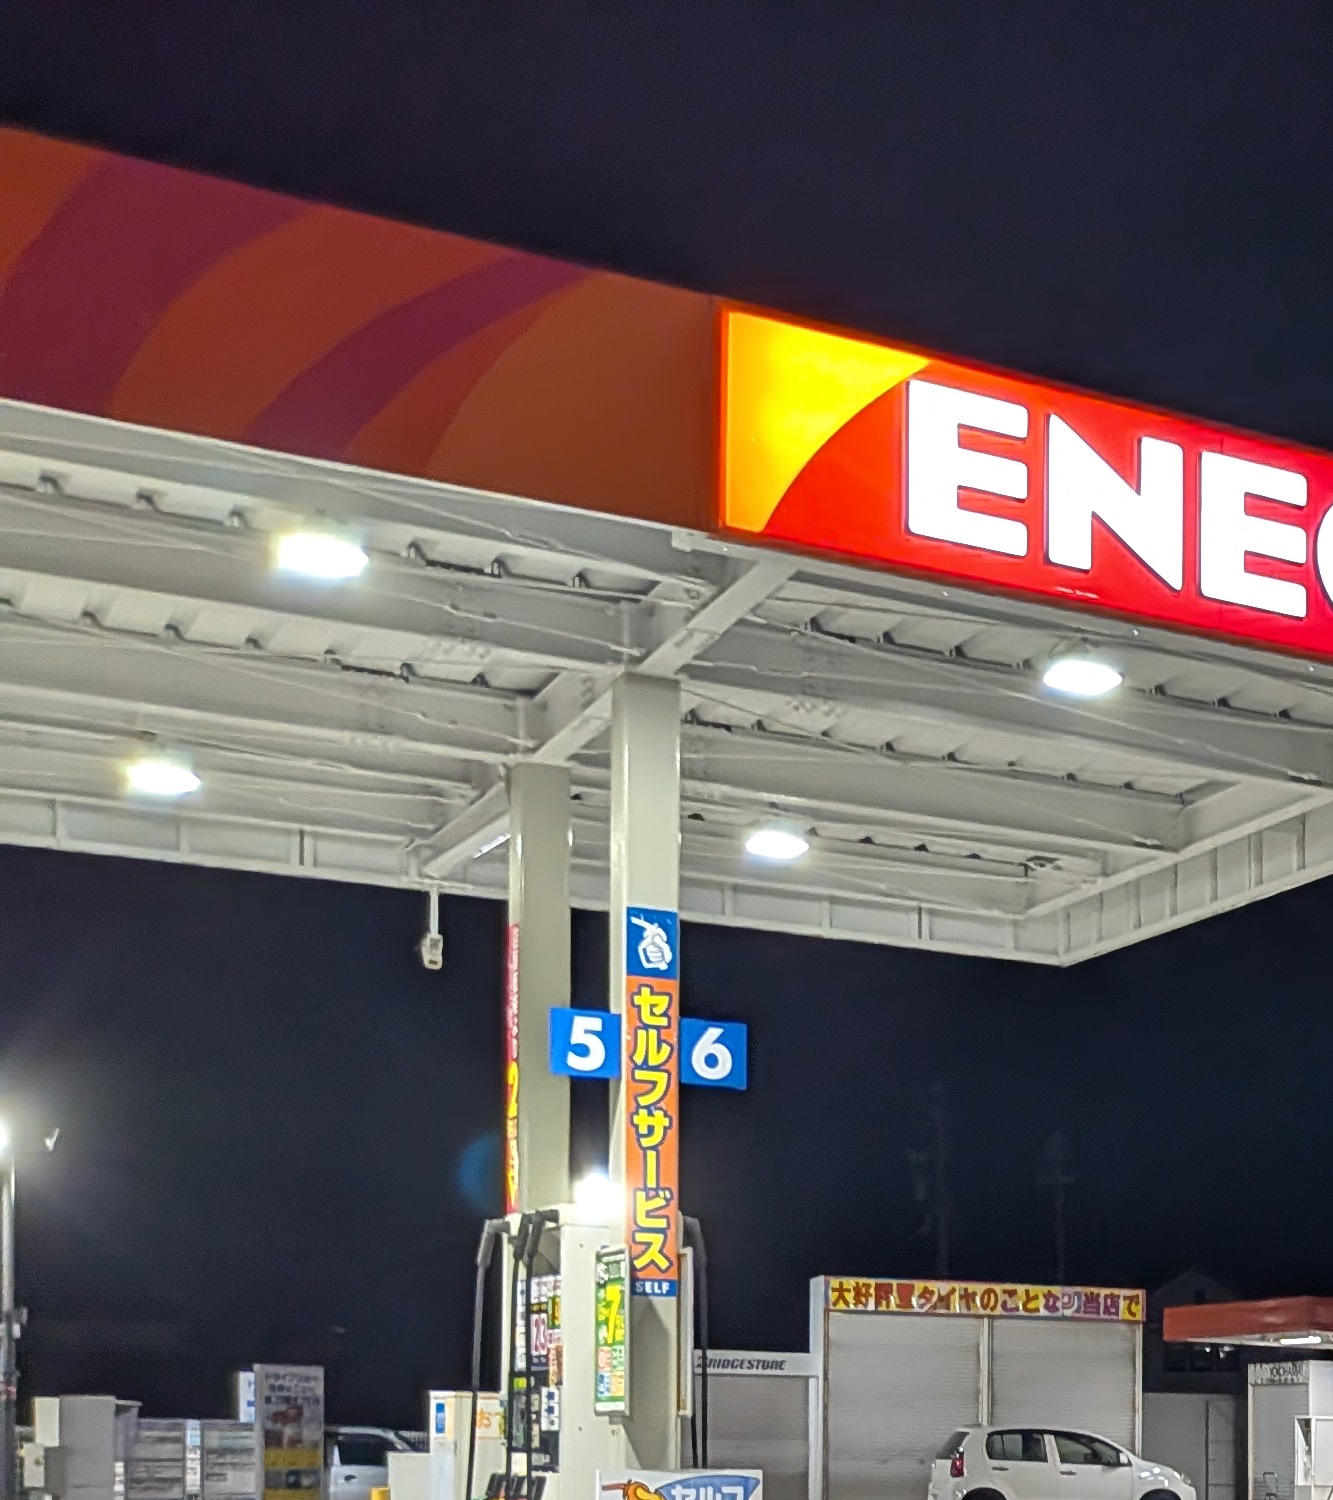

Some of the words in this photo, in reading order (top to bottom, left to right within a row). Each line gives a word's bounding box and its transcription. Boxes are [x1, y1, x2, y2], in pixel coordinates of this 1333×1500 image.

[566, 1015, 606, 1071] 5
[691, 1026, 733, 1080] 6
[632, 986, 673, 1272] セルフサービス
[634, 1280, 671, 1294] SELF
